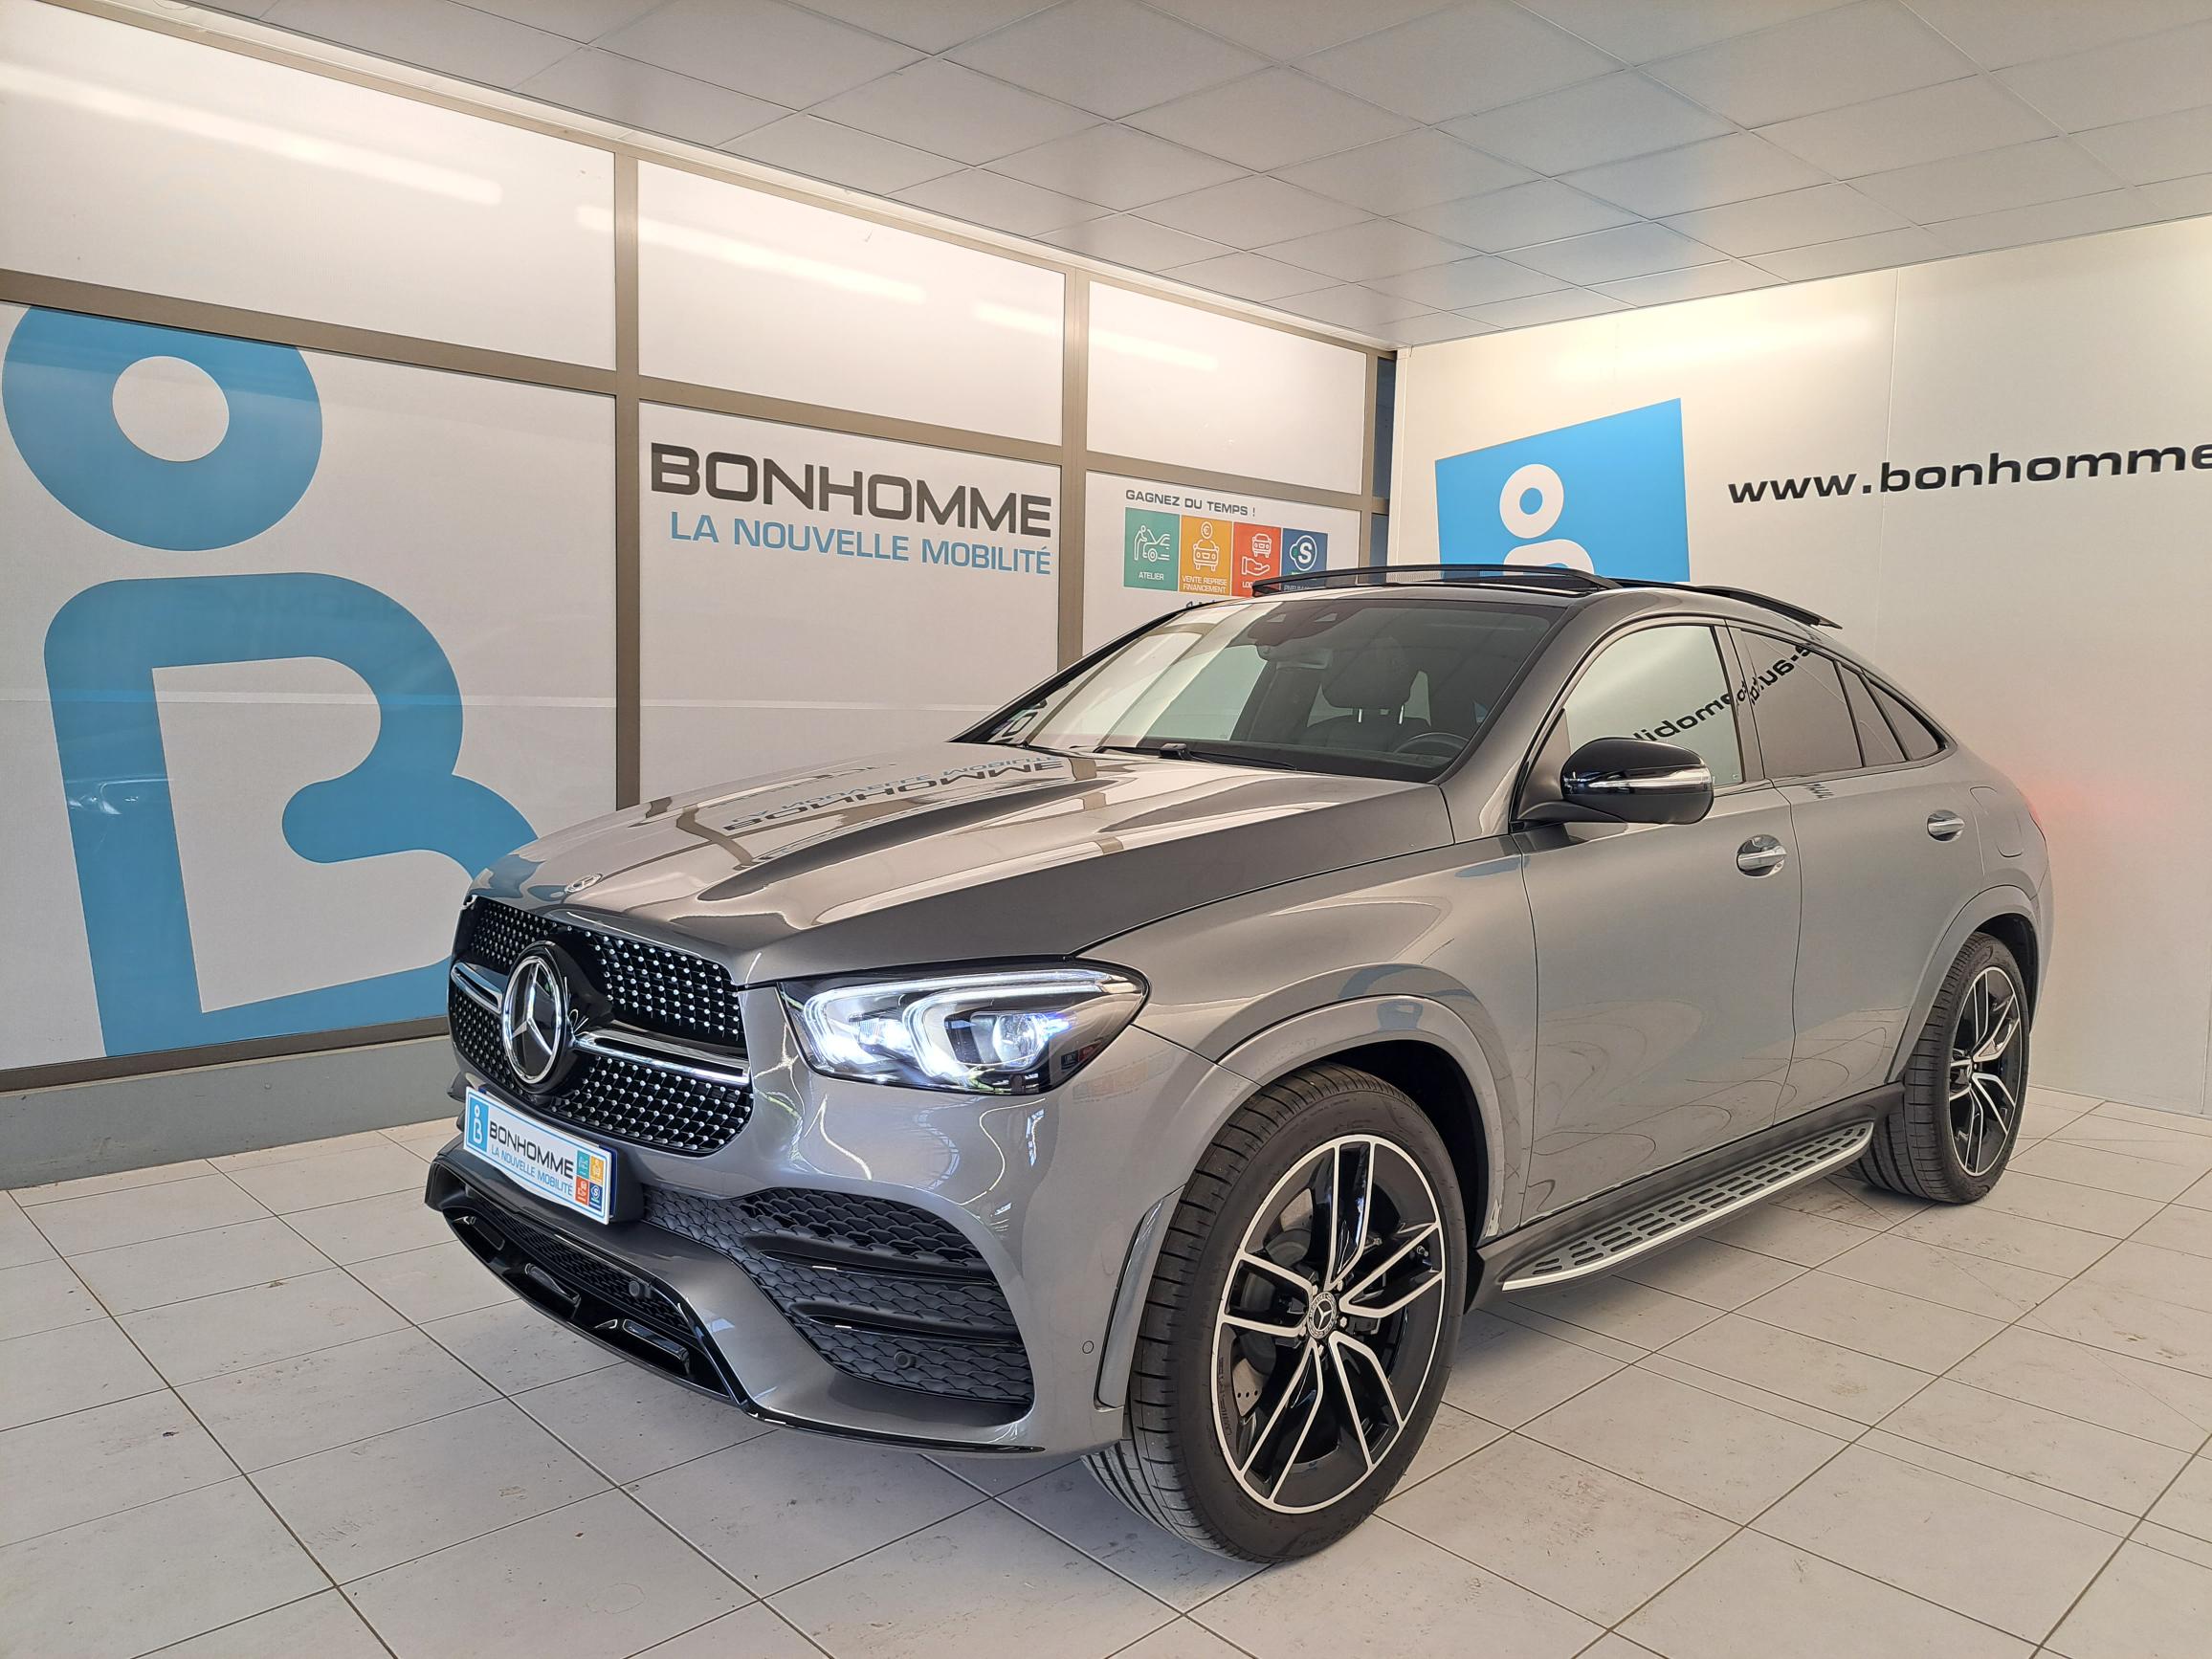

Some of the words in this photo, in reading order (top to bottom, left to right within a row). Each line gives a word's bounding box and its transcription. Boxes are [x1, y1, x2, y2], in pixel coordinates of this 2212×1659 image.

[652, 442, 1051, 538] BONHOMME
[1727, 443, 2212, 504] www.bonhomme
[1125, 489, 1180, 506] GAGNEZ
[1184, 498, 1203, 510] DU
[1206, 500, 1248, 516] TEMPS
[1252, 507, 1255, 517] !
[671, 511, 719, 542] LA
[734, 518, 909, 562] NOUVELLE
[921, 539, 1051, 574] MOBILITÉ
[1139, 571, 1164, 581] ATELIER
[1182, 575, 1203, 584] VENTE
[1204, 577, 1228, 586] REPRISE
[1183, 583, 1226, 593] FINANCEMENT
[489, 1120, 574, 1180] BONHOMME
[491, 1145, 499, 1156] LA
[501, 1148, 536, 1178] NOUVELLE
[537, 1171, 573, 1196] MOBILITÉ
